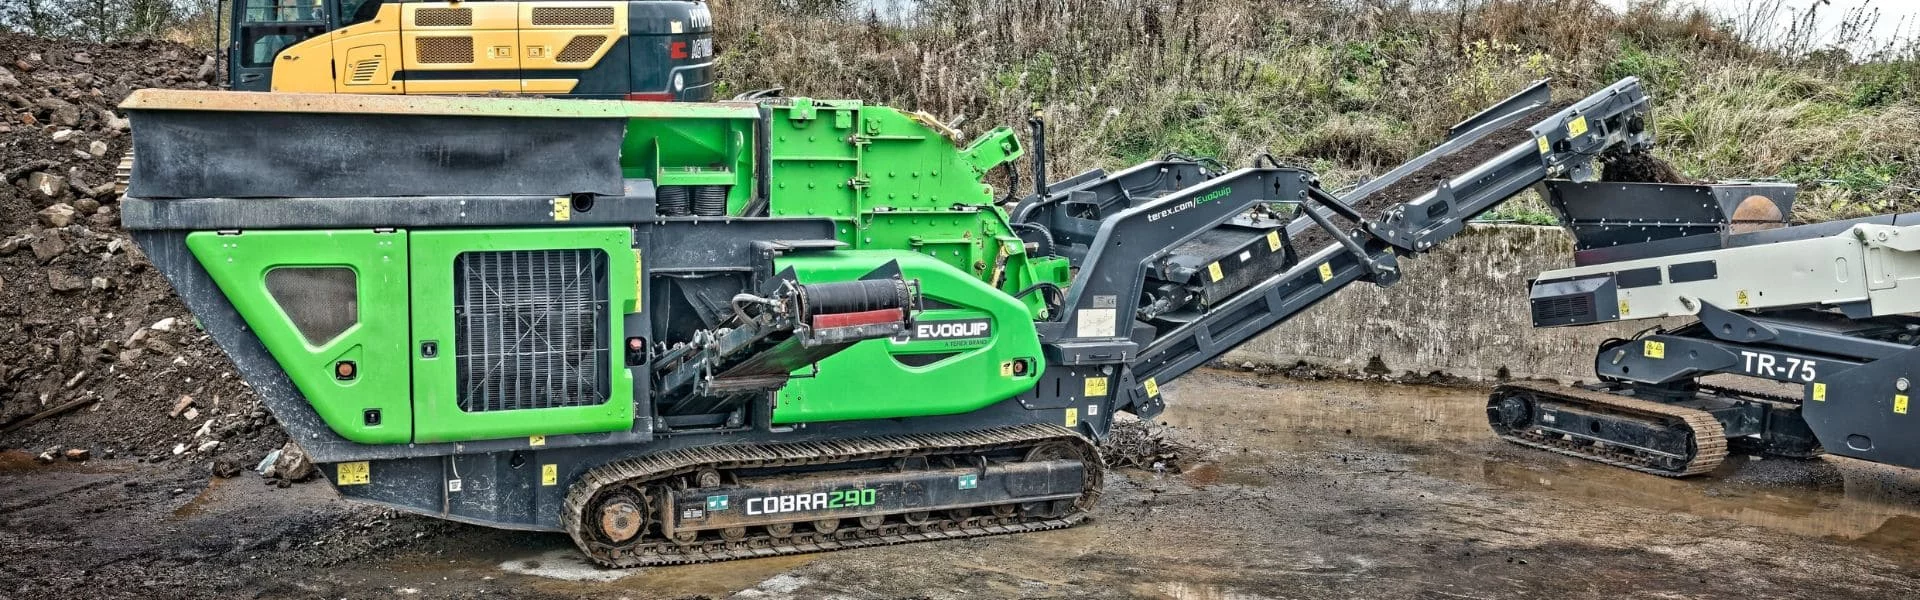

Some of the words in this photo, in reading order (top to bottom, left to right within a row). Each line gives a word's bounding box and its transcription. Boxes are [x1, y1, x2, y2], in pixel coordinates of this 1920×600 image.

[1147, 186, 1232, 222] terex.com/EvoQuip
[917, 322, 988, 338] EVOQUIP
[1741, 351, 1816, 382] TR-75
